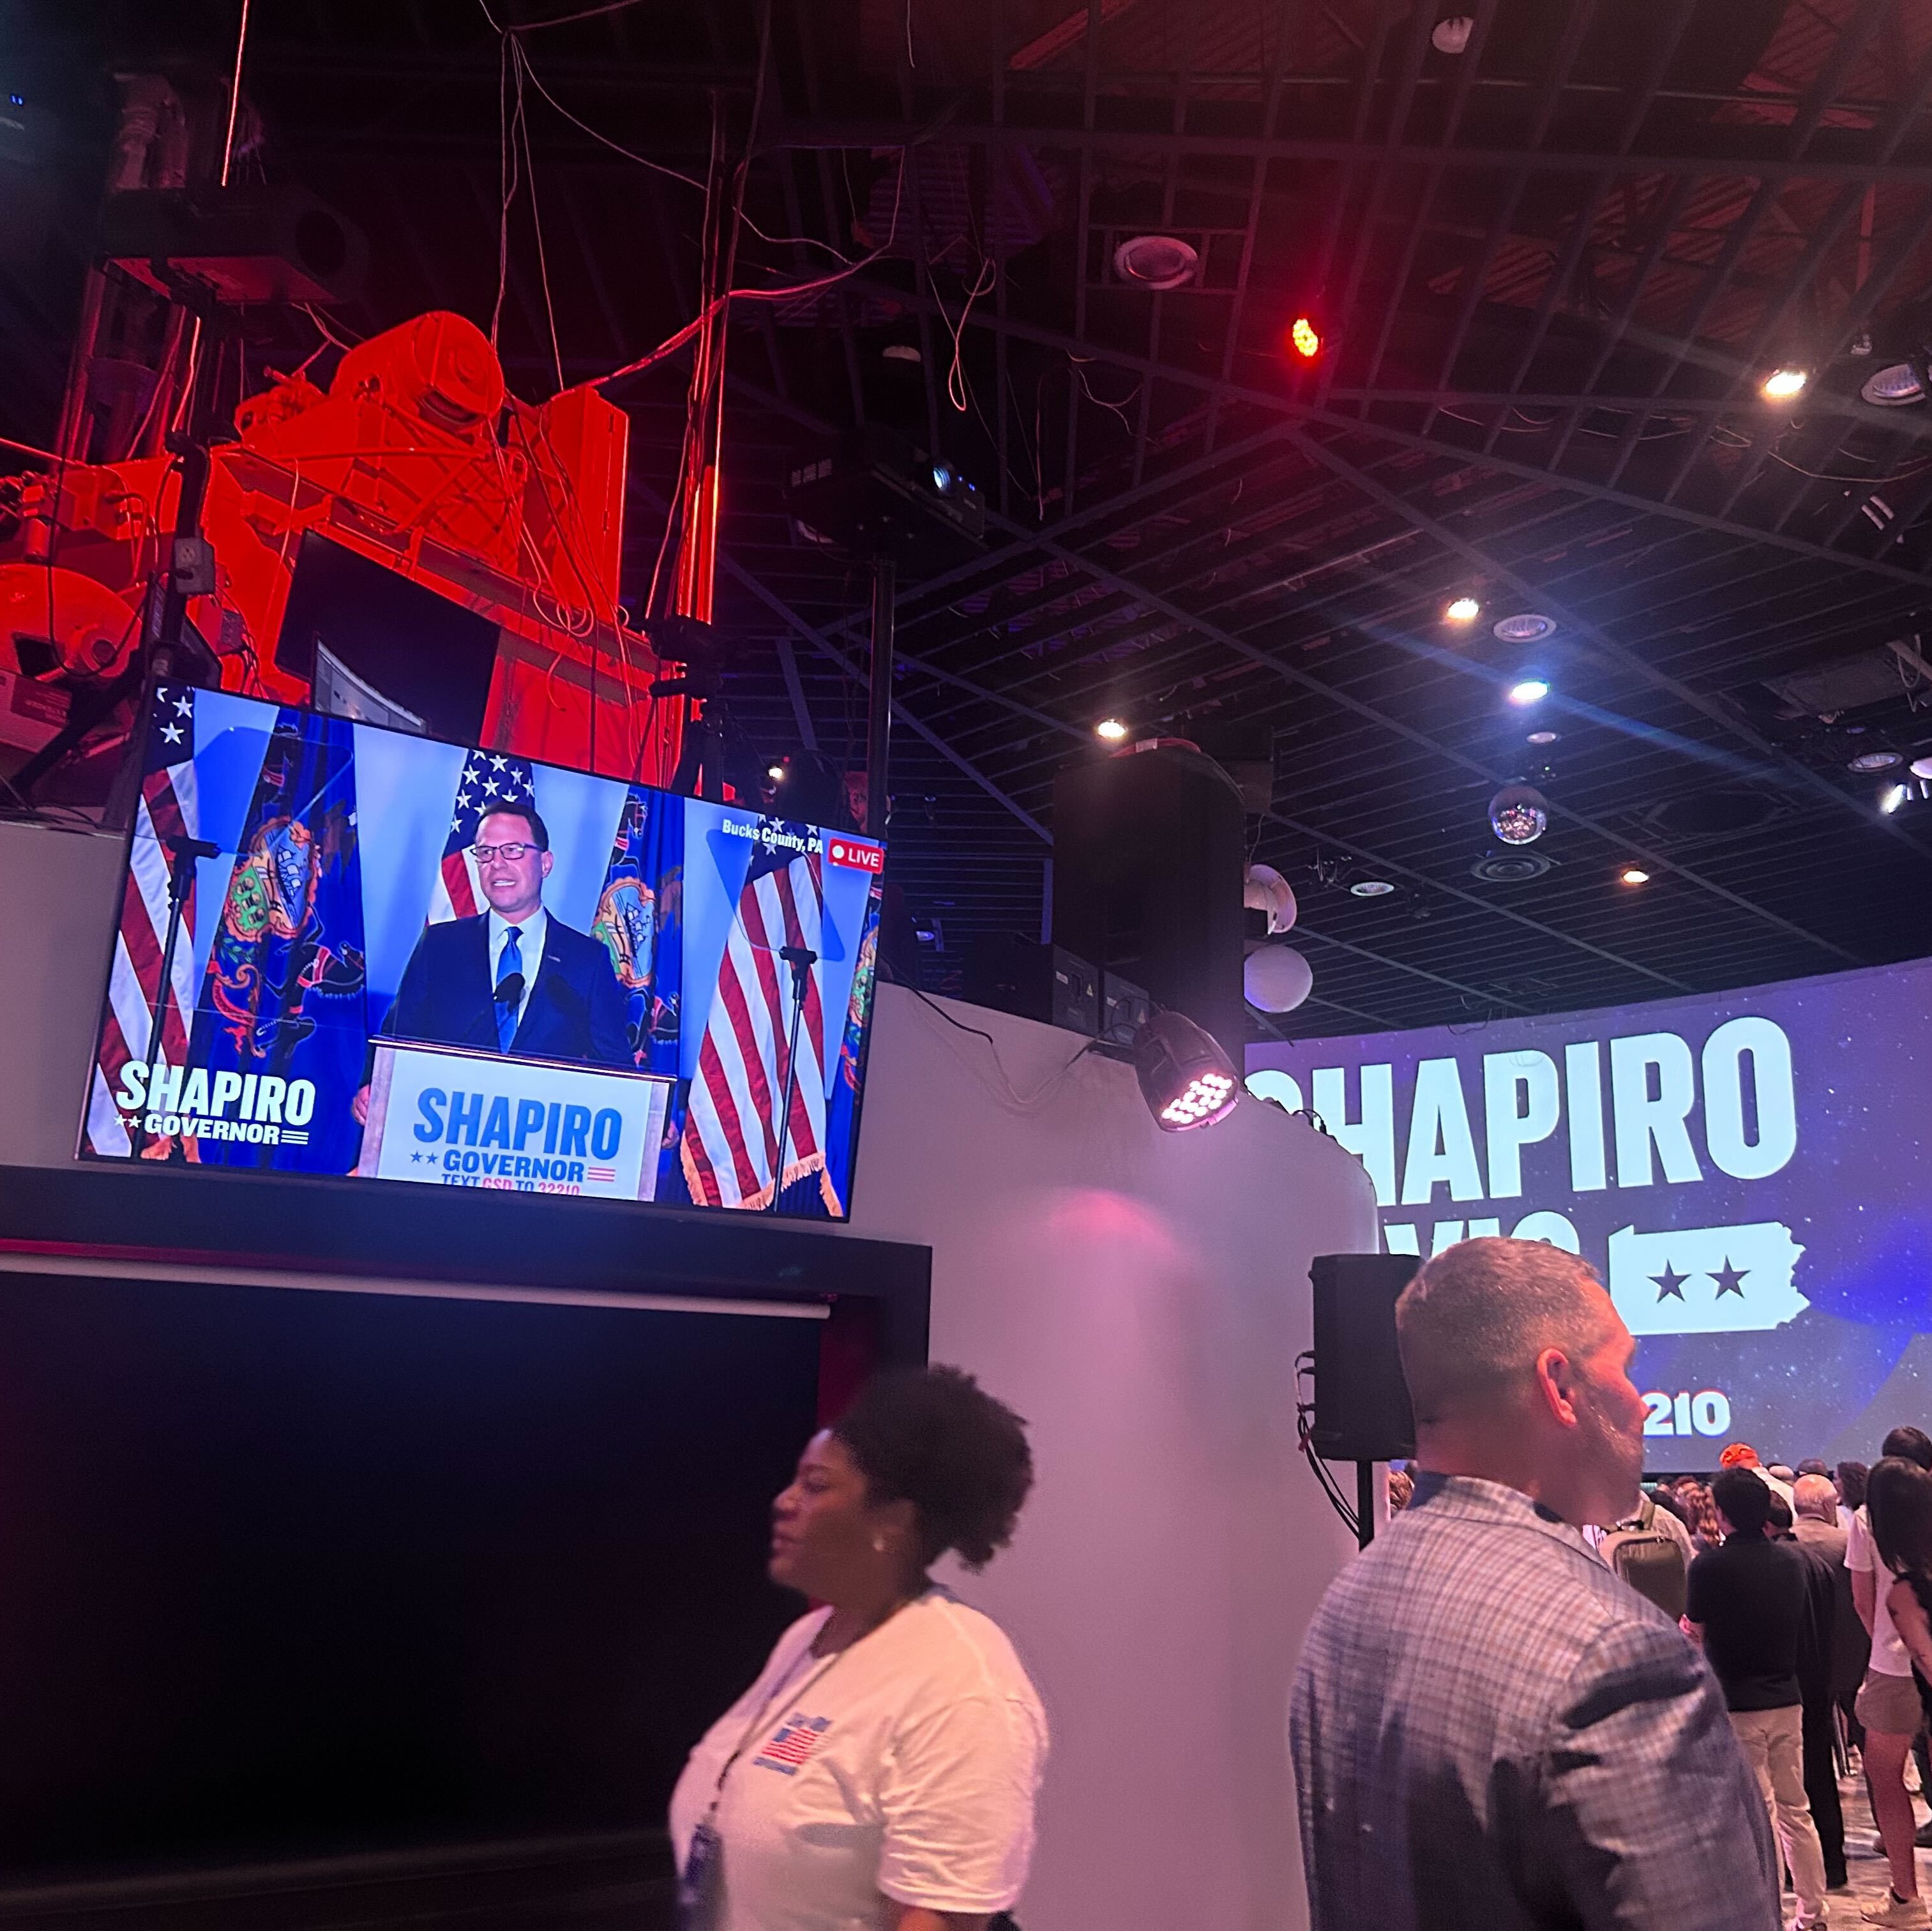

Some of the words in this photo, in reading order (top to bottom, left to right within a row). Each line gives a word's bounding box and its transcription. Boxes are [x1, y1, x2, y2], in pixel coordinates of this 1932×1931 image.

[722, 819, 759, 840] Bucks
[761, 828, 804, 852] County,
[808, 837, 824, 854] PA
[848, 847, 879, 867] LIVE
[116, 1061, 315, 1126] SHAPIRO
[144, 1113, 280, 1145] GOVERNOR
[413, 1087, 622, 1160] SHAPIRO
[443, 1149, 584, 1182] GOVERNOR
